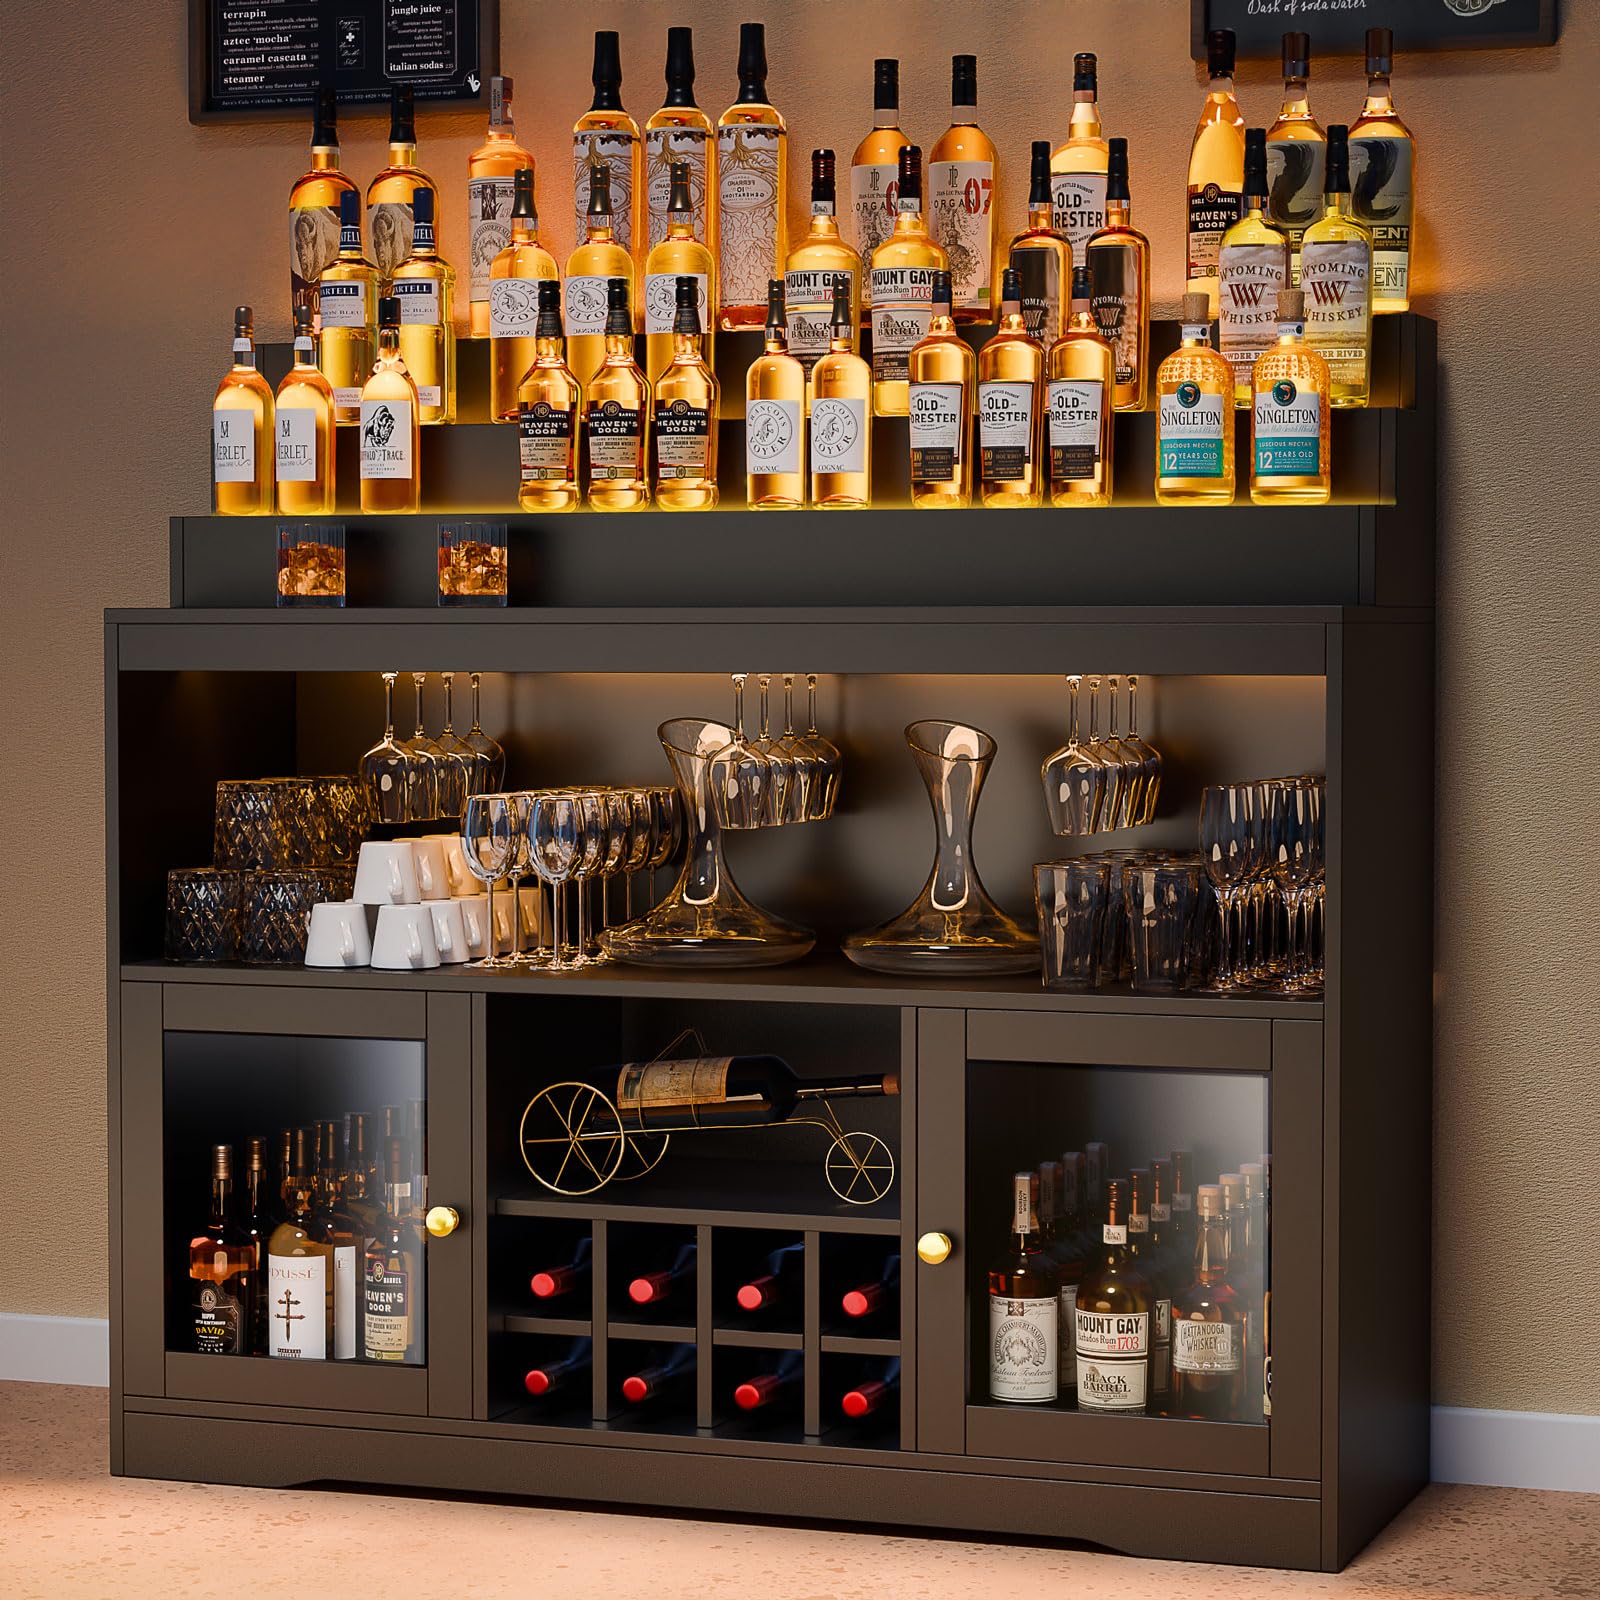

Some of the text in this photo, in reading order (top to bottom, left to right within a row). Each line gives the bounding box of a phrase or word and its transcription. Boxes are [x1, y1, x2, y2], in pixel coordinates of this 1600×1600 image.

[390, 4, 442, 16] jungle juice
[1284, 0, 1299, 15] of
[223, 8, 267, 20] terrapin
[223, 37, 250, 46] aztec
[223, 54, 264, 65] caramel
[268, 54, 306, 63] cascata
[390, 60, 444, 72] italian sodas
[223, 76, 265, 84] steamer
[1058, 192, 1082, 208] OLD
[1054, 211, 1103, 228] RESTER
[1190, 211, 1238, 222] HEAVEN'S
[1372, 227, 1408, 239] ENT
[1220, 265, 1282, 282] WYOMING
[1302, 262, 1365, 279] WYOMING
[786, 273, 819, 288] MOUNT
[872, 271, 933, 289] MOUNT GAY
[1373, 267, 1406, 287] ENT
[321, 288, 356, 296] ARTELL
[395, 285, 430, 293] ARTELL
[806, 288, 822, 296] Rum
[823, 290, 833, 300] 17
[892, 285, 910, 294] Rum
[911, 286, 932, 297] 1703
[1221, 309, 1279, 324] WHISKEY
[1304, 306, 1362, 322] WHISKEY
[880, 320, 920, 329] BLACK
[792, 330, 829, 338] BARRE
[878, 327, 924, 336] BARREL
[1097, 326, 1126, 336] HISKEY
[917, 398, 938, 411] OLD
[988, 397, 1009, 409] OLD
[1058, 396, 1079, 408] OLD
[911, 413, 956, 424] ORESTER
[981, 412, 1028, 422] ORESTER
[1051, 410, 1097, 421] ORESTER
[1162, 408, 1221, 426] SINGLETON
[1257, 406, 1316, 425] SINGLETON
[220, 421, 229, 438] M
[282, 420, 291, 437] M
[589, 420, 638, 428] HEAVEN'S
[750, 436, 787, 455] VOYER
[814, 434, 852, 454] VOYER
[382, 449, 403, 461] TRACE
[1259, 452, 1273, 469] 12
[1164, 453, 1177, 470] 12
[367, 1292, 404, 1304] EAVEN'S
[369, 1302, 392, 1312] DOOR
[1078, 1314, 1140, 1334] MOUNT GAY
[196, 1326, 225, 1336] DAVID
[1100, 1335, 1116, 1344] Rum
[1118, 1337, 1139, 1350] 1703
[1187, 1336, 1217, 1352] WHISKEY
[1086, 1373, 1126, 1384] BLACK
[1083, 1381, 1131, 1392] BARREL
